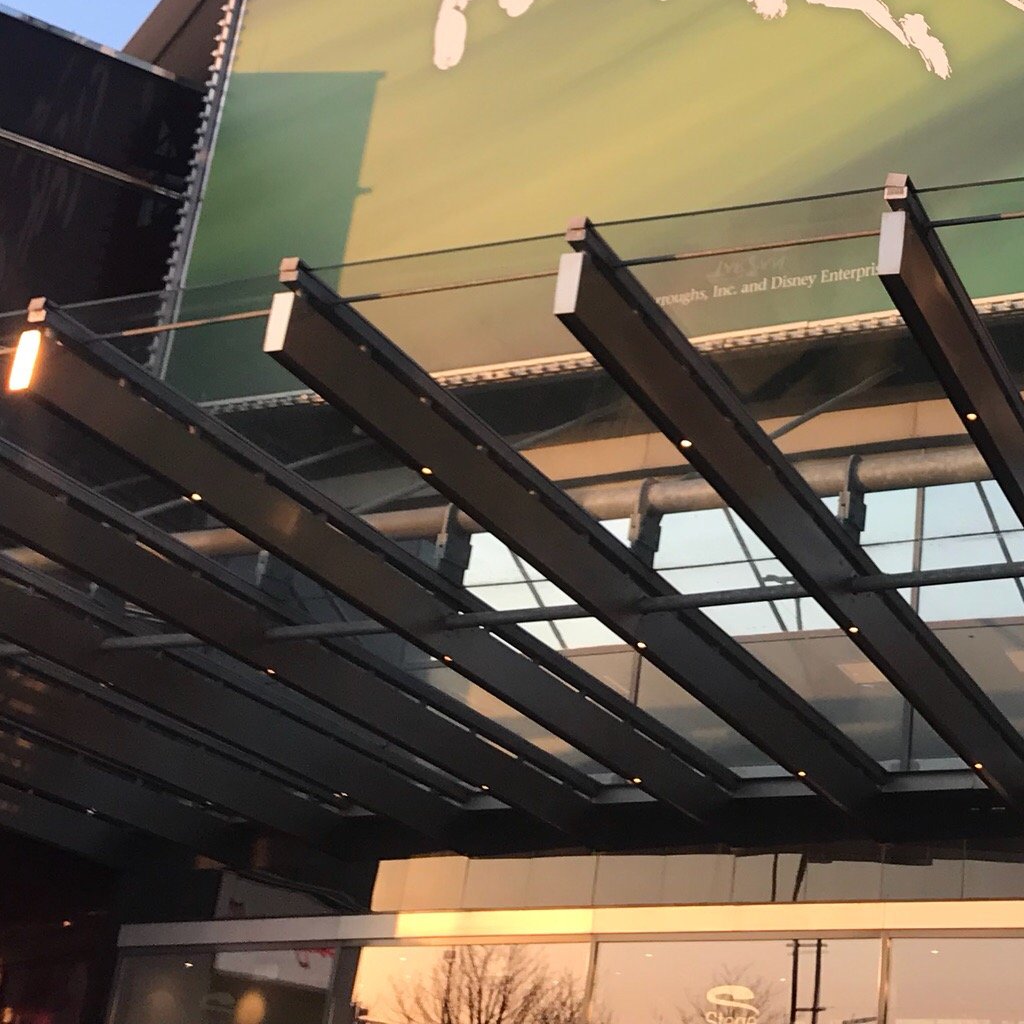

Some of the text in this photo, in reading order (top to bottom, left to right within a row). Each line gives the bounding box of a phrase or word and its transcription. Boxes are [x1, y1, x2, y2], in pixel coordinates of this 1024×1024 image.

[713, 285, 738, 298] Inc.
[740, 277, 767, 294] and
[770, 275, 818, 289] Disney
